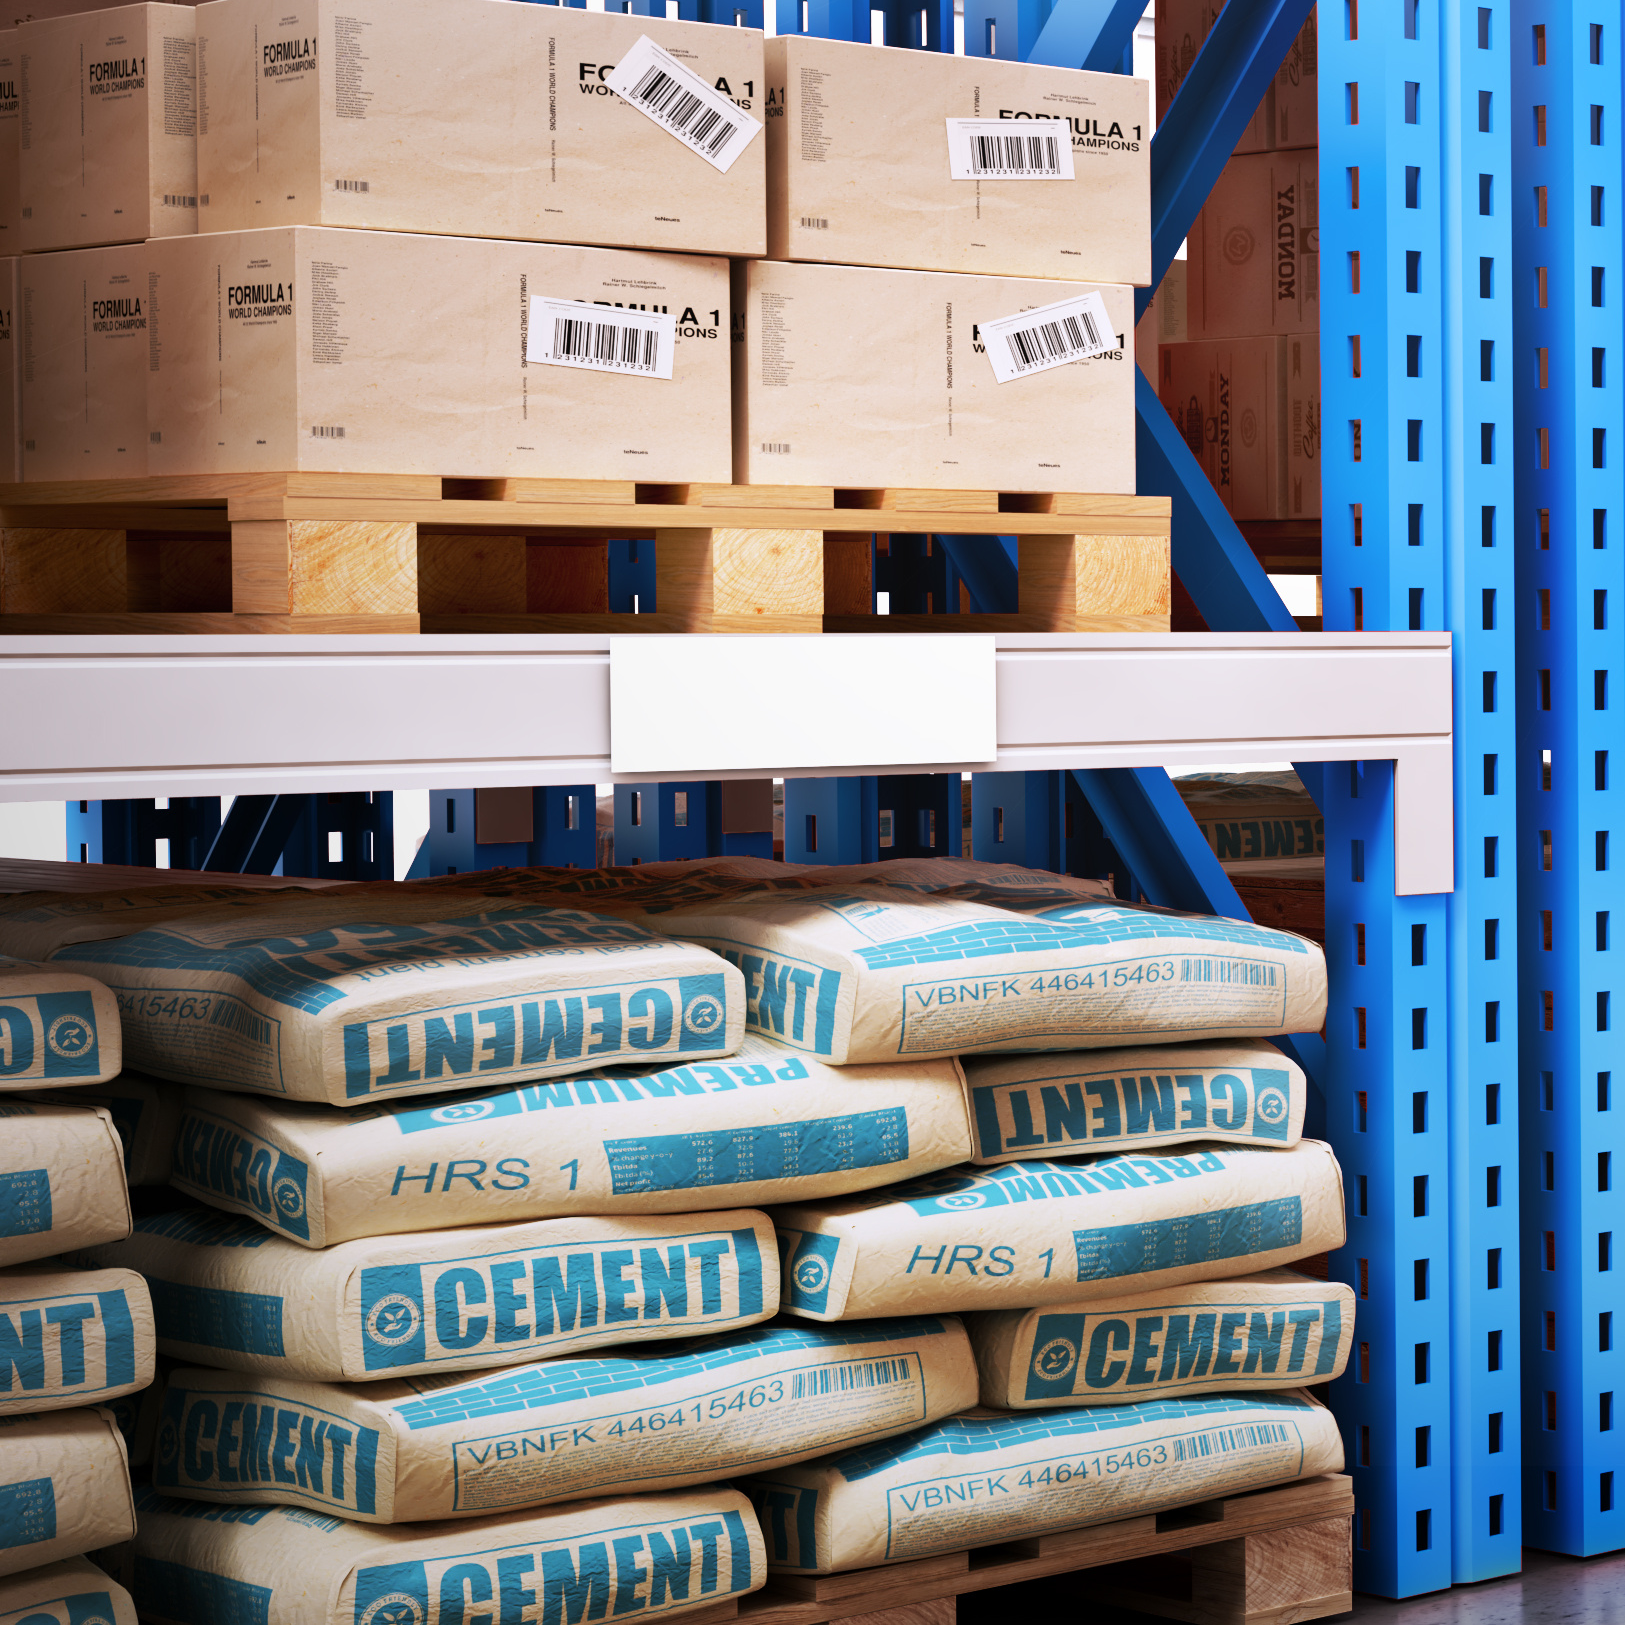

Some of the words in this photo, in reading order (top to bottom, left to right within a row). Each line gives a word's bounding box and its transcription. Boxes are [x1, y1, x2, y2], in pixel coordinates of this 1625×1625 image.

[264, 39, 309, 65] FORMULA
[312, 37, 317, 56] 1
[89, 58, 138, 83] FORMULA
[141, 57, 145, 75] 1
[264, 65, 284, 78] WORLD
[284, 59, 316, 76] CHAMPIONS
[89, 81, 110, 96] WORLD
[111, 78, 145, 92] CHAMPIONS
[1071, 137, 1140, 152] HAMPIONS
[1133, 125, 1141, 141] 1
[228, 283, 285, 306] FORMULA
[287, 283, 293, 302] 1
[228, 306, 252, 319] WORLD
[253, 304, 292, 318] CHAMPIONS
[458, 947, 585, 968] cement
[599, 941, 688, 956] Local
[360, 961, 445, 983] plant
[914, 980, 1021, 1007] VBNFK
[1031, 961, 1175, 994] 446415463
[375, 988, 674, 1086] CEMENT
[1005, 1073, 1249, 1148] CEMENT
[608, 1145, 647, 1153] Revenues
[391, 1156, 532, 1197] HRS
[558, 1157, 584, 1191] 1
[906, 1245, 1016, 1277] HRS
[1038, 1248, 1055, 1278] 1
[433, 1241, 731, 1350] CEMENT
[1084, 1311, 1322, 1388] CEMENT
[466, 1425, 603, 1464] VBNFK
[607, 1373, 785, 1438] 446415463
[184, 1398, 353, 1501] CEMENT
[900, 1476, 1010, 1513] VBNFK
[1018, 1444, 1168, 1489] 446415463
[440, 1522, 735, 1625] CEMENT
